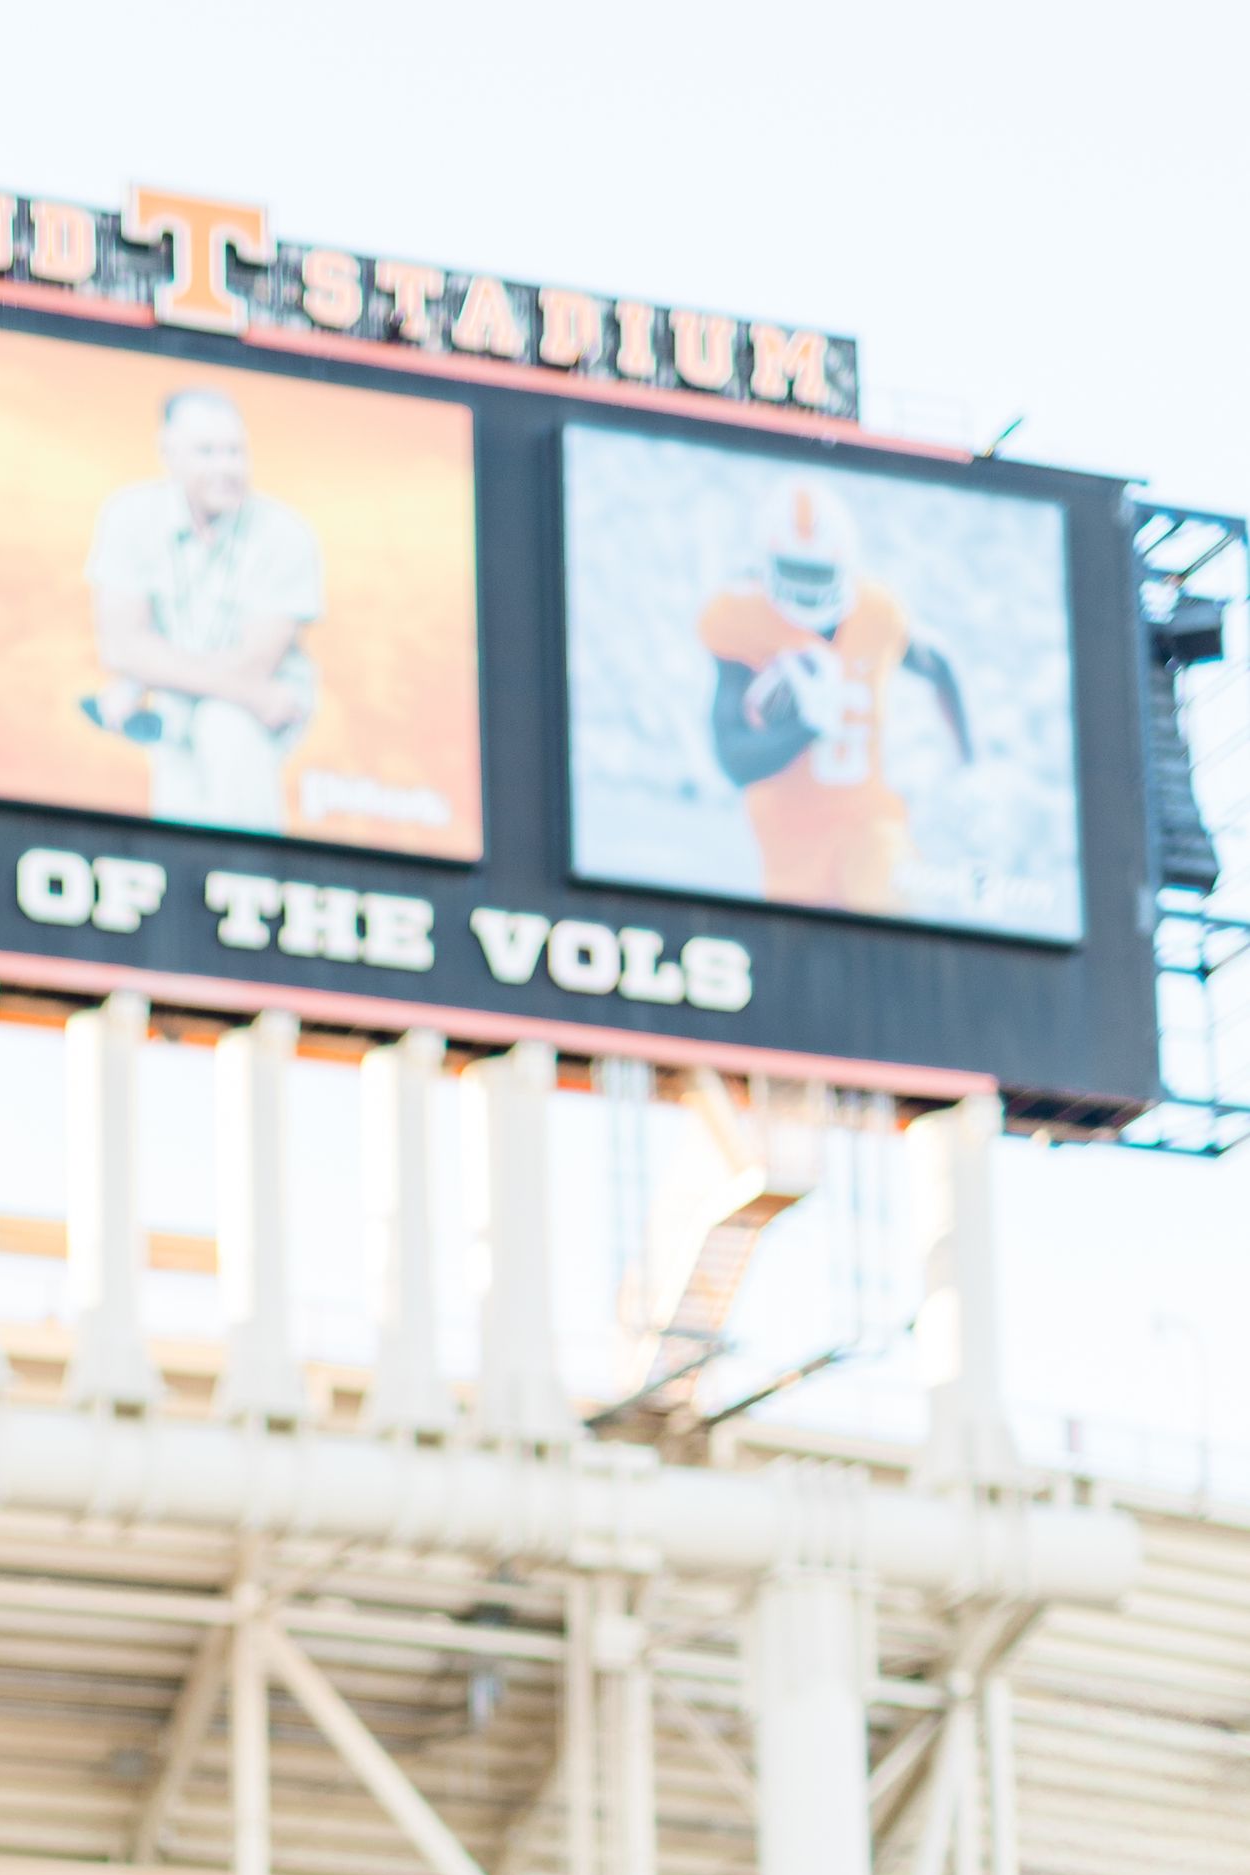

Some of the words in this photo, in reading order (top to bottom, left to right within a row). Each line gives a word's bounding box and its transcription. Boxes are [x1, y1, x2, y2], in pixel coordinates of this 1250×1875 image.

[121, 184, 277, 335] T
[301, 249, 832, 404] STADIUM
[16, 847, 167, 934] OF
[204, 870, 435, 972] THE
[469, 906, 752, 1012] VOLS
